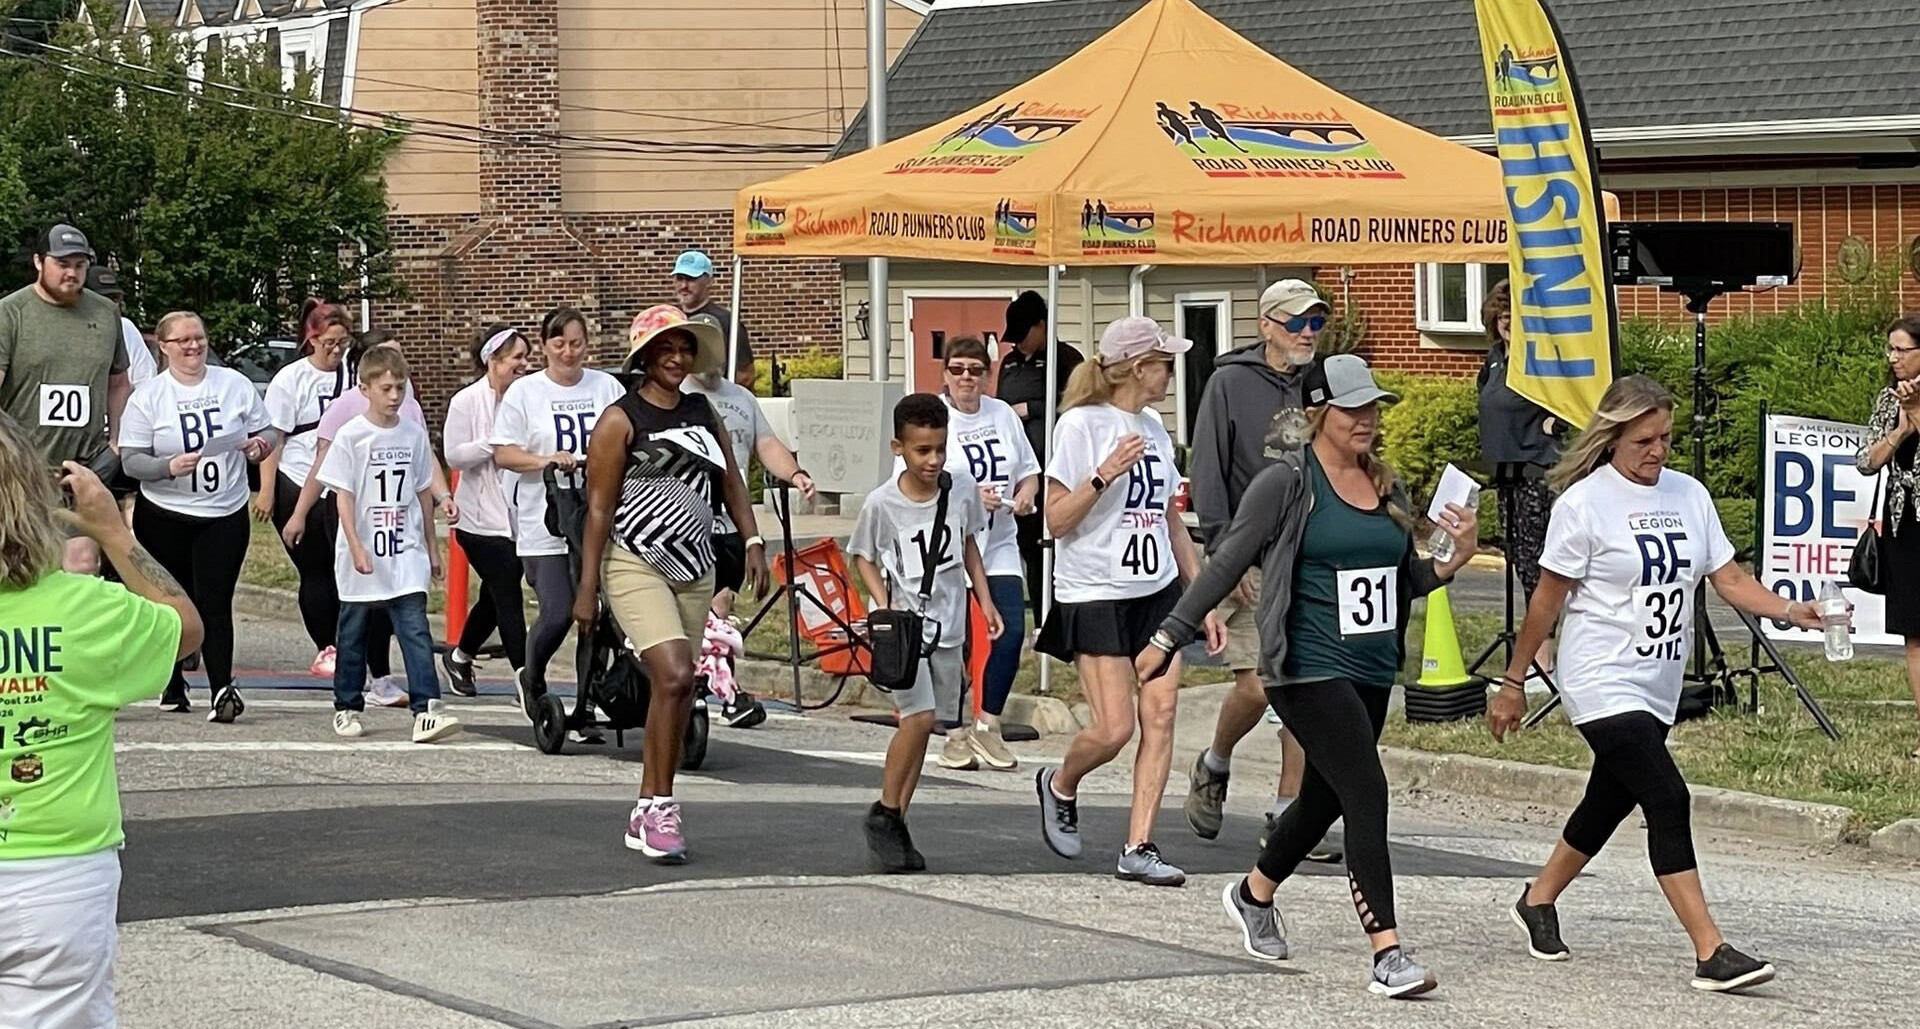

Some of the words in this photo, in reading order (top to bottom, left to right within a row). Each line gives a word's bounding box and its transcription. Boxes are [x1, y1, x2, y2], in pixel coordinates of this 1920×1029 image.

[1216, 103, 1347, 121] Richmond
[1494, 95, 1514, 107] ROA
[1192, 158, 1247, 171] ROAD
[1248, 158, 1341, 171] RUNNERS
[1343, 159, 1396, 172] CLUB
[793, 206, 867, 236] Richmond
[869, 211, 898, 237] ROAD
[901, 213, 954, 240] RUNNERS
[956, 216, 986, 241] CLUB
[1172, 209, 1305, 244] Richmond
[1311, 218, 1361, 243] ROAD
[1368, 218, 1456, 244] RUNNERS
[1462, 219, 1508, 244] CLUB
[1497, 123, 1595, 376] FINISH
[48, 390, 82, 422] 20
[177, 399, 219, 411] LEGION
[551, 402, 594, 411] LEGION
[957, 429, 997, 443] LEGION
[1774, 430, 1860, 448] LEGION
[1798, 424, 1860, 434] AMERICAN
[370, 451, 412, 461] LEGION
[962, 438, 1009, 482] BE
[374, 469, 406, 502] 17
[1125, 455, 1164, 509] BE
[1773, 451, 1858, 539] BE
[1628, 518, 1684, 530] LEGION
[1121, 533, 1159, 575] 40
[1791, 543, 1839, 575] THE
[1350, 574, 1388, 626] 31
[1645, 588, 1684, 638] 32
